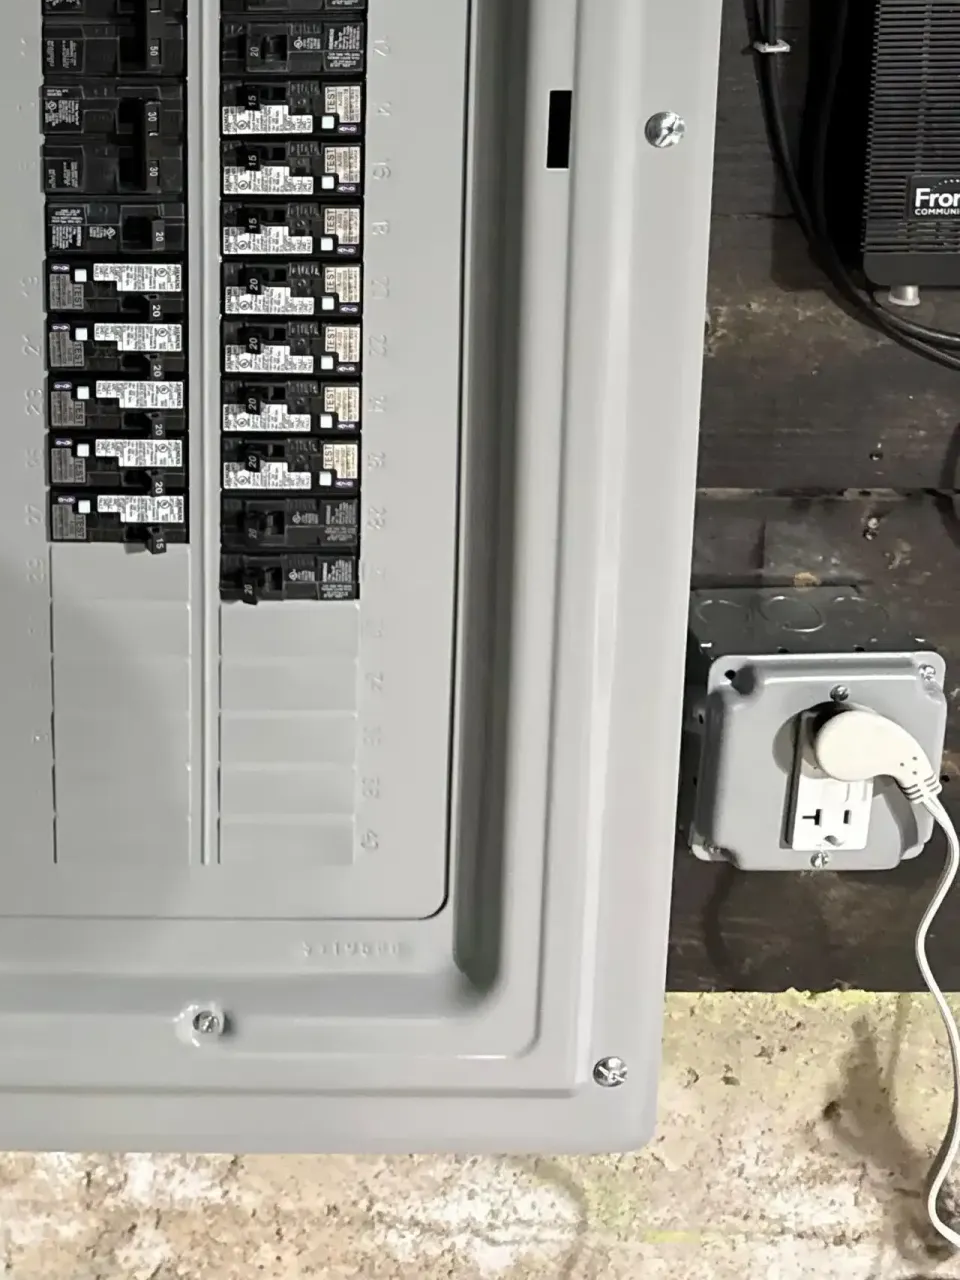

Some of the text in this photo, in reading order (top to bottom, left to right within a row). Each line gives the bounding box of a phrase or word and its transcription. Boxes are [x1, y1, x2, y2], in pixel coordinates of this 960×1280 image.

[150, 46, 158, 56] 50
[250, 46, 259, 57] 20
[373, 37, 391, 57] 12
[248, 95, 256, 106] 15
[148, 112, 157, 122] 30
[248, 154, 257, 166] 15
[327, 149, 335, 172] TEST
[149, 166, 158, 177] 30
[373, 159, 391, 180] 16
[248, 217, 257, 229] 15
[326, 209, 334, 232] TEST
[155, 232, 164, 242] 20
[249, 277, 258, 291] 20
[326, 268, 334, 291] TEST
[73, 285, 82, 308] TEST
[152, 304, 161, 317] 20
[248, 337, 257, 350] 20
[327, 328, 335, 350] TEST
[74, 344, 83, 366] TEST
[153, 364, 161, 377] 20
[25, 388, 43, 415] 23
[248, 397, 256, 410] 20
[326, 388, 334, 410] TEST
[75, 402, 83, 425] TEST
[155, 424, 163, 436] 20
[248, 455, 256, 468] 20
[75, 460, 83, 482] TEST
[155, 481, 163, 494] 20
[76, 516, 84, 538] TEST
[249, 528, 257, 539] 20
[156, 537, 164, 549] 15
[244, 584, 253, 595] 20
